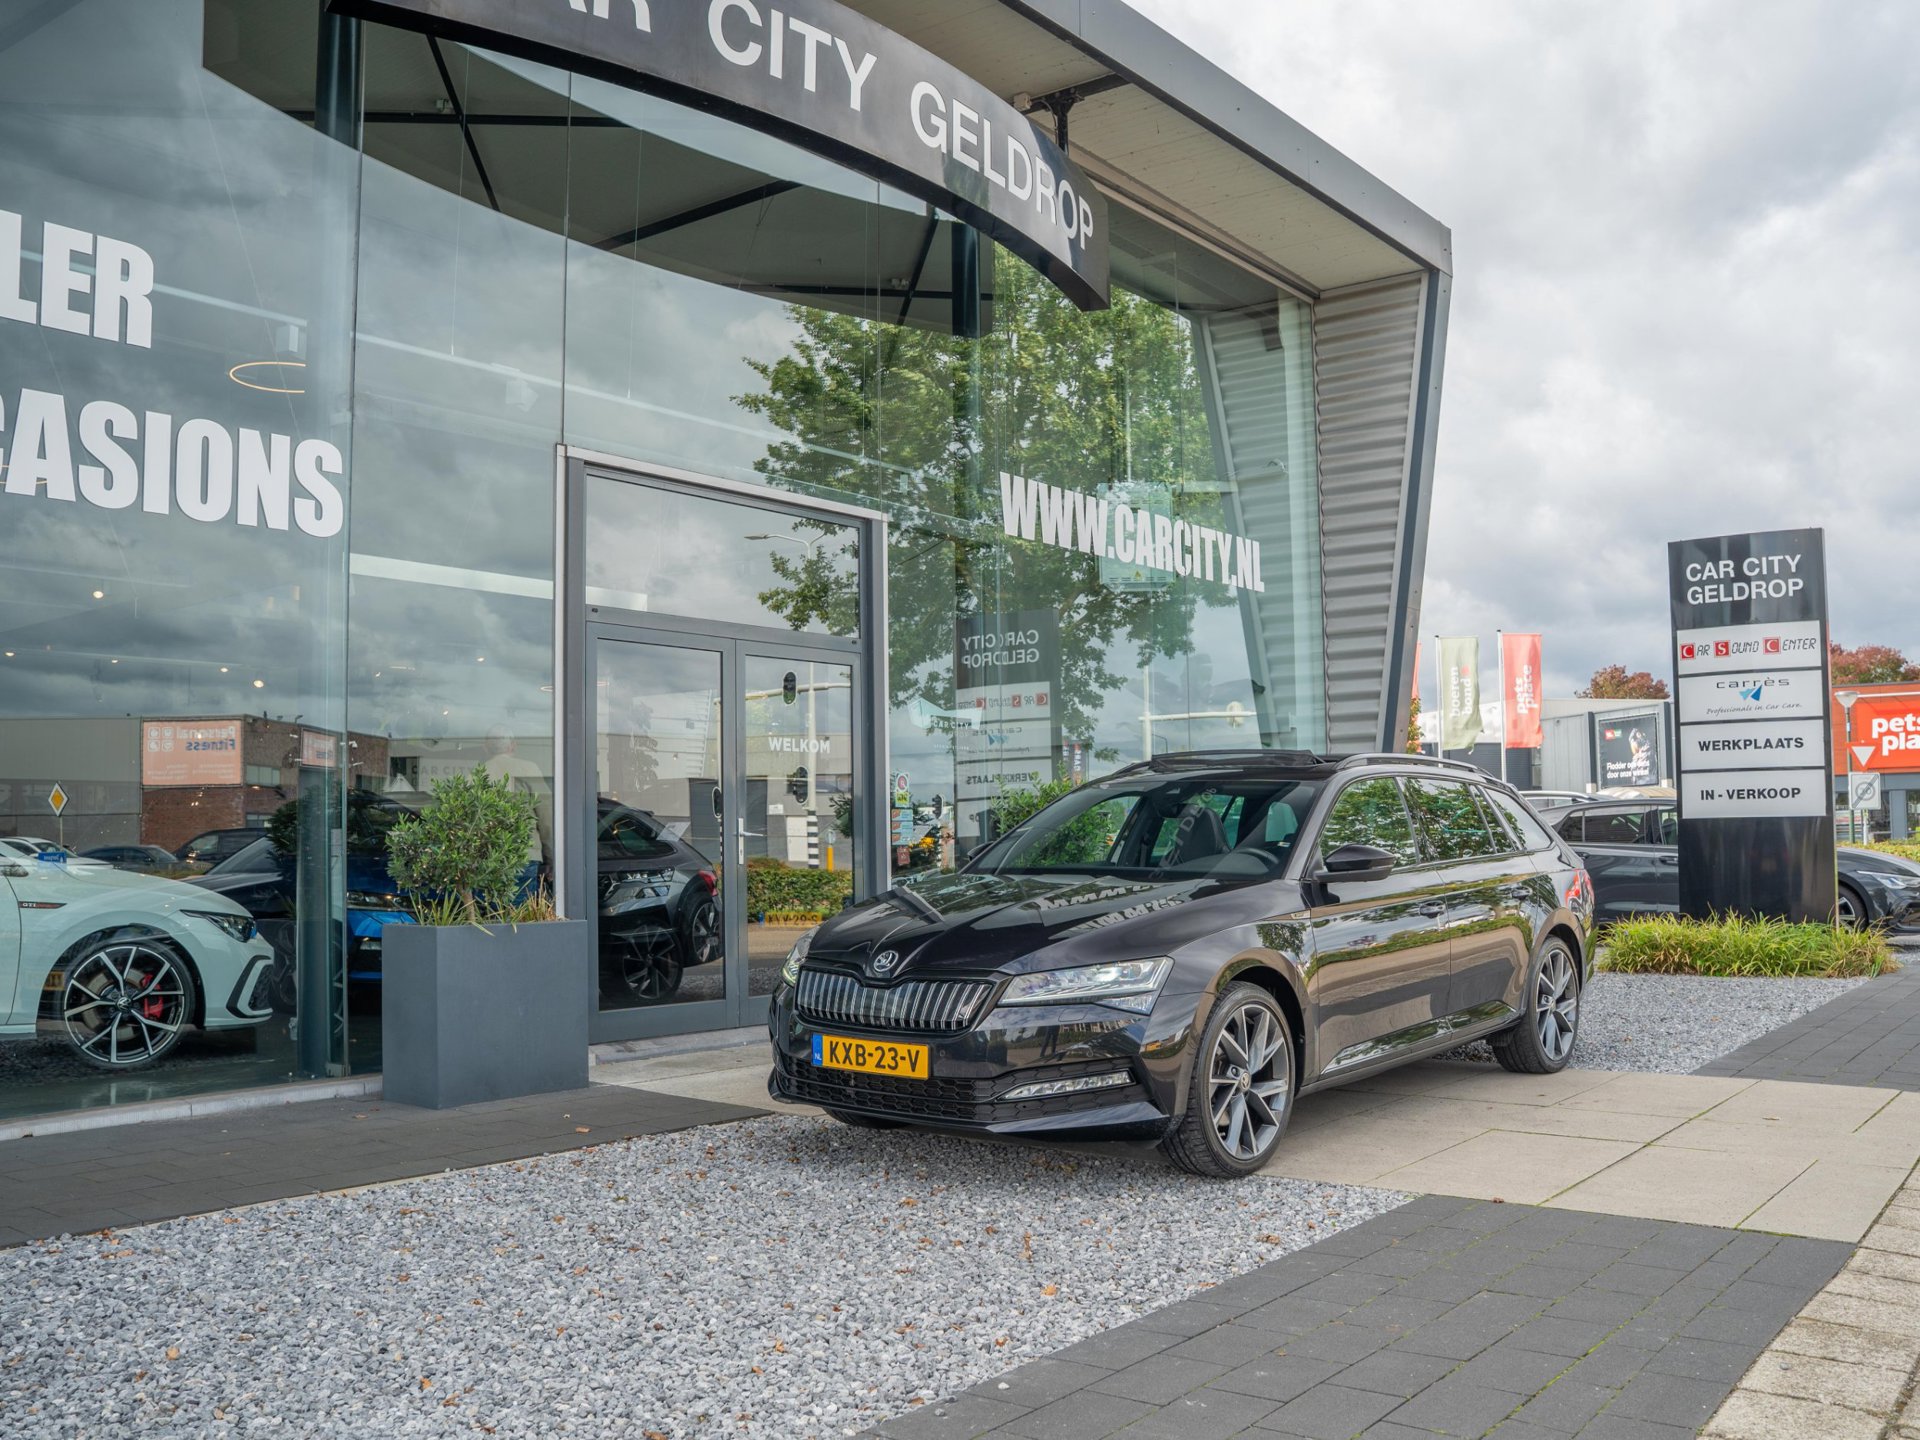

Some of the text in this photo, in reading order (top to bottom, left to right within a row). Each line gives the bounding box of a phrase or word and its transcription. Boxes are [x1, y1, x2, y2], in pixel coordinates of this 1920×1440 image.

[708, 0, 1094, 250] CITY GELDROP
[0, 388, 344, 538] ASIONS
[999, 471, 1265, 593] WWW.CARCITY.NL
[1686, 554, 1801, 582] CAR CITY
[1687, 578, 1804, 605] GELDROP
[1450, 666, 1461, 717] boeren
[1461, 678, 1473, 715] bond
[1514, 676, 1528, 714] pets
[1523, 664, 1538, 708] place
[1872, 713, 1920, 739] pet
[768, 737, 831, 754] WELKOM
[1698, 737, 1804, 751] WERKPLAATS
[1701, 790, 1715, 801] IN
[1727, 788, 1801, 800] VERKOOP
[829, 1040, 920, 1072] KXB-23-V
